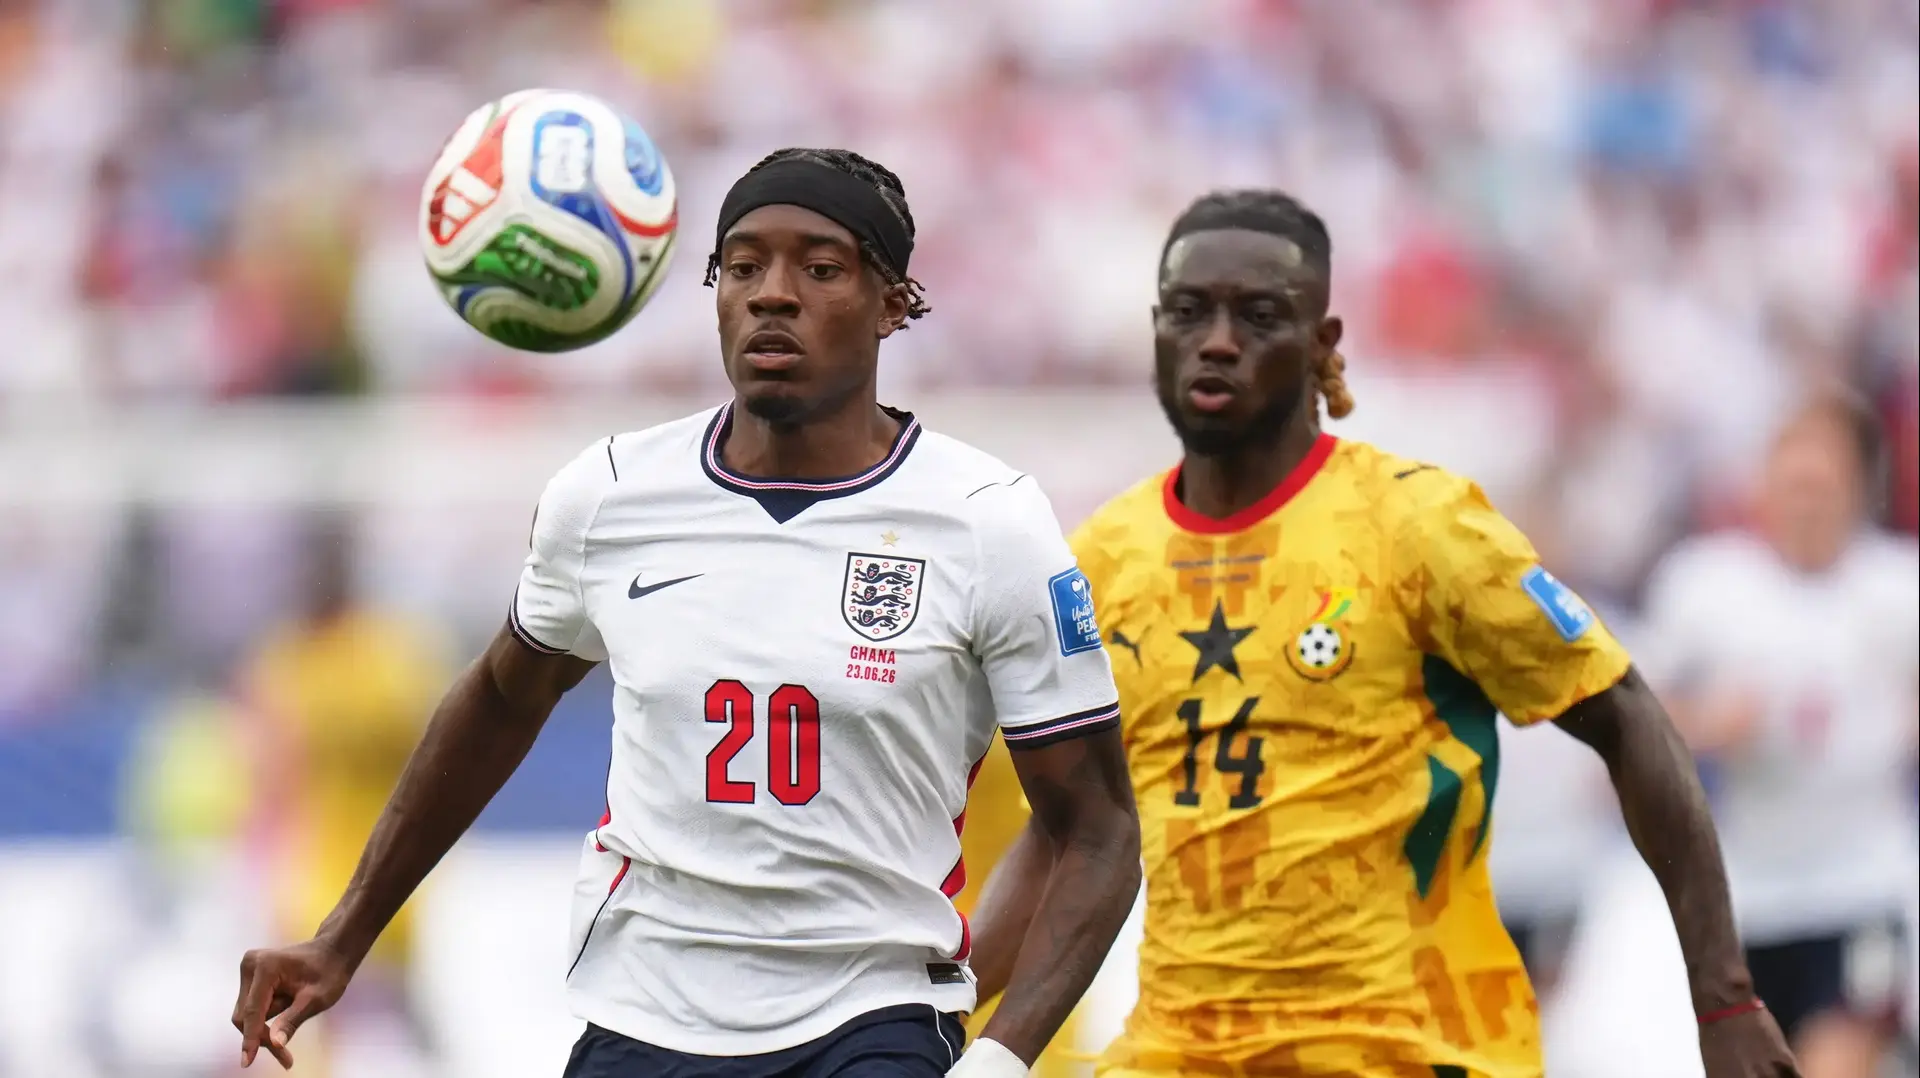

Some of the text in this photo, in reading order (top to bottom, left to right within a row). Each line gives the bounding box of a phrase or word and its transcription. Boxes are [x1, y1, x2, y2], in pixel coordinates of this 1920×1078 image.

[1077, 615, 1098, 635] PEA
[850, 645, 896, 665] GHANA
[846, 663, 896, 683] 23.06.26
[704, 678, 821, 806] 20
[1174, 696, 1265, 810] 14
